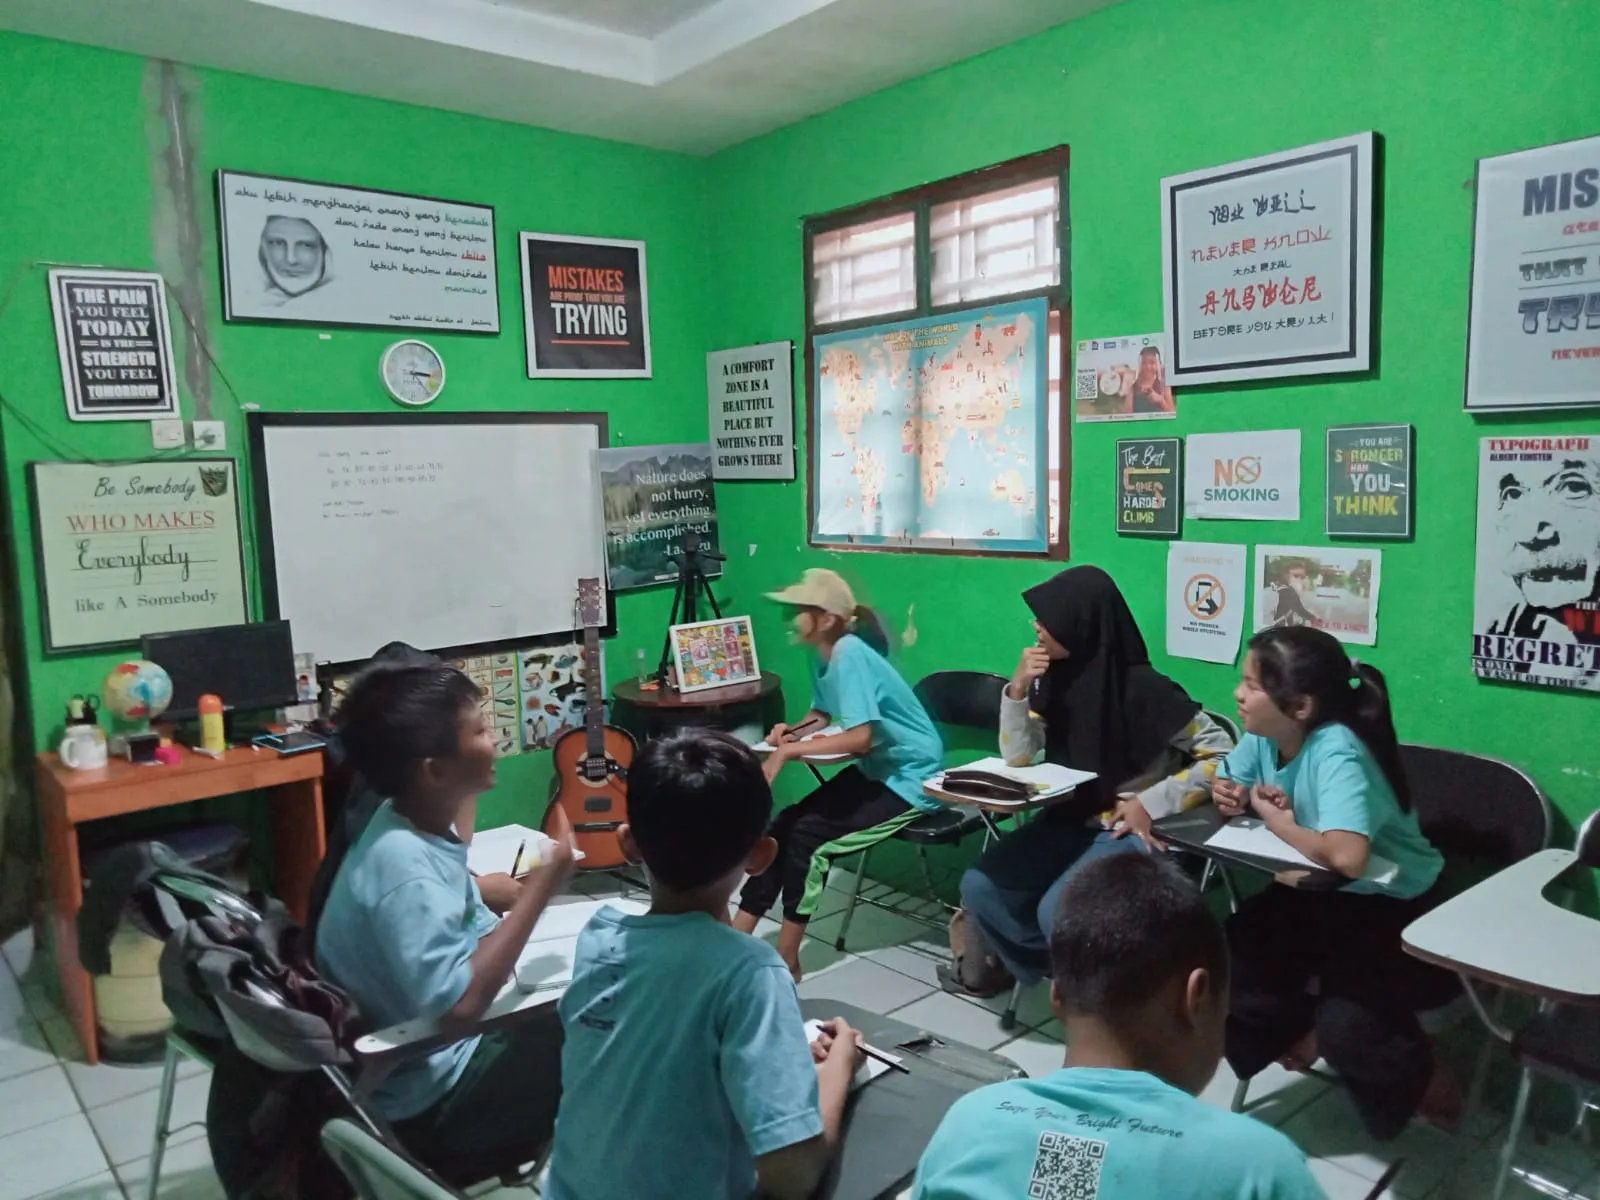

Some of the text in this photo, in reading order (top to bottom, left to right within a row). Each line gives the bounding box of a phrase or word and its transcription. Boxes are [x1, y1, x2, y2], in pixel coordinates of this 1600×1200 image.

[547, 265, 625, 292] MISTAKES
[72, 287, 149, 305] THE PAIN
[75, 305, 150, 319] YOU FEEL
[550, 302, 628, 336] TRYING
[77, 319, 150, 337] TODAY
[81, 351, 157, 367] STRENGTH
[722, 358, 775, 376] A COMFORT
[84, 368, 117, 380] YOU
[725, 378, 769, 394] ZONE IS A
[722, 397, 775, 413] BEAUTIFUL
[724, 416, 774, 431] PLACE BUT
[716, 434, 784, 450] NOTHING EVER
[718, 453, 783, 467] GROWS THERE
[635, 471, 677, 486] Nature
[1350, 473, 1392, 494] YOU
[94, 475, 197, 501] Be Somebody
[651, 490, 672, 503] not
[1203, 488, 1280, 502] SMOKING
[647, 504, 710, 522] everything
[1333, 495, 1399, 516] THINK
[66, 510, 216, 532] WHO MAKES
[77, 536, 190, 586] Everybody
[75, 588, 219, 613] like A Somebody
[1075, 1113, 1121, 1132] Bright
[1127, 1117, 1185, 1139] Future
